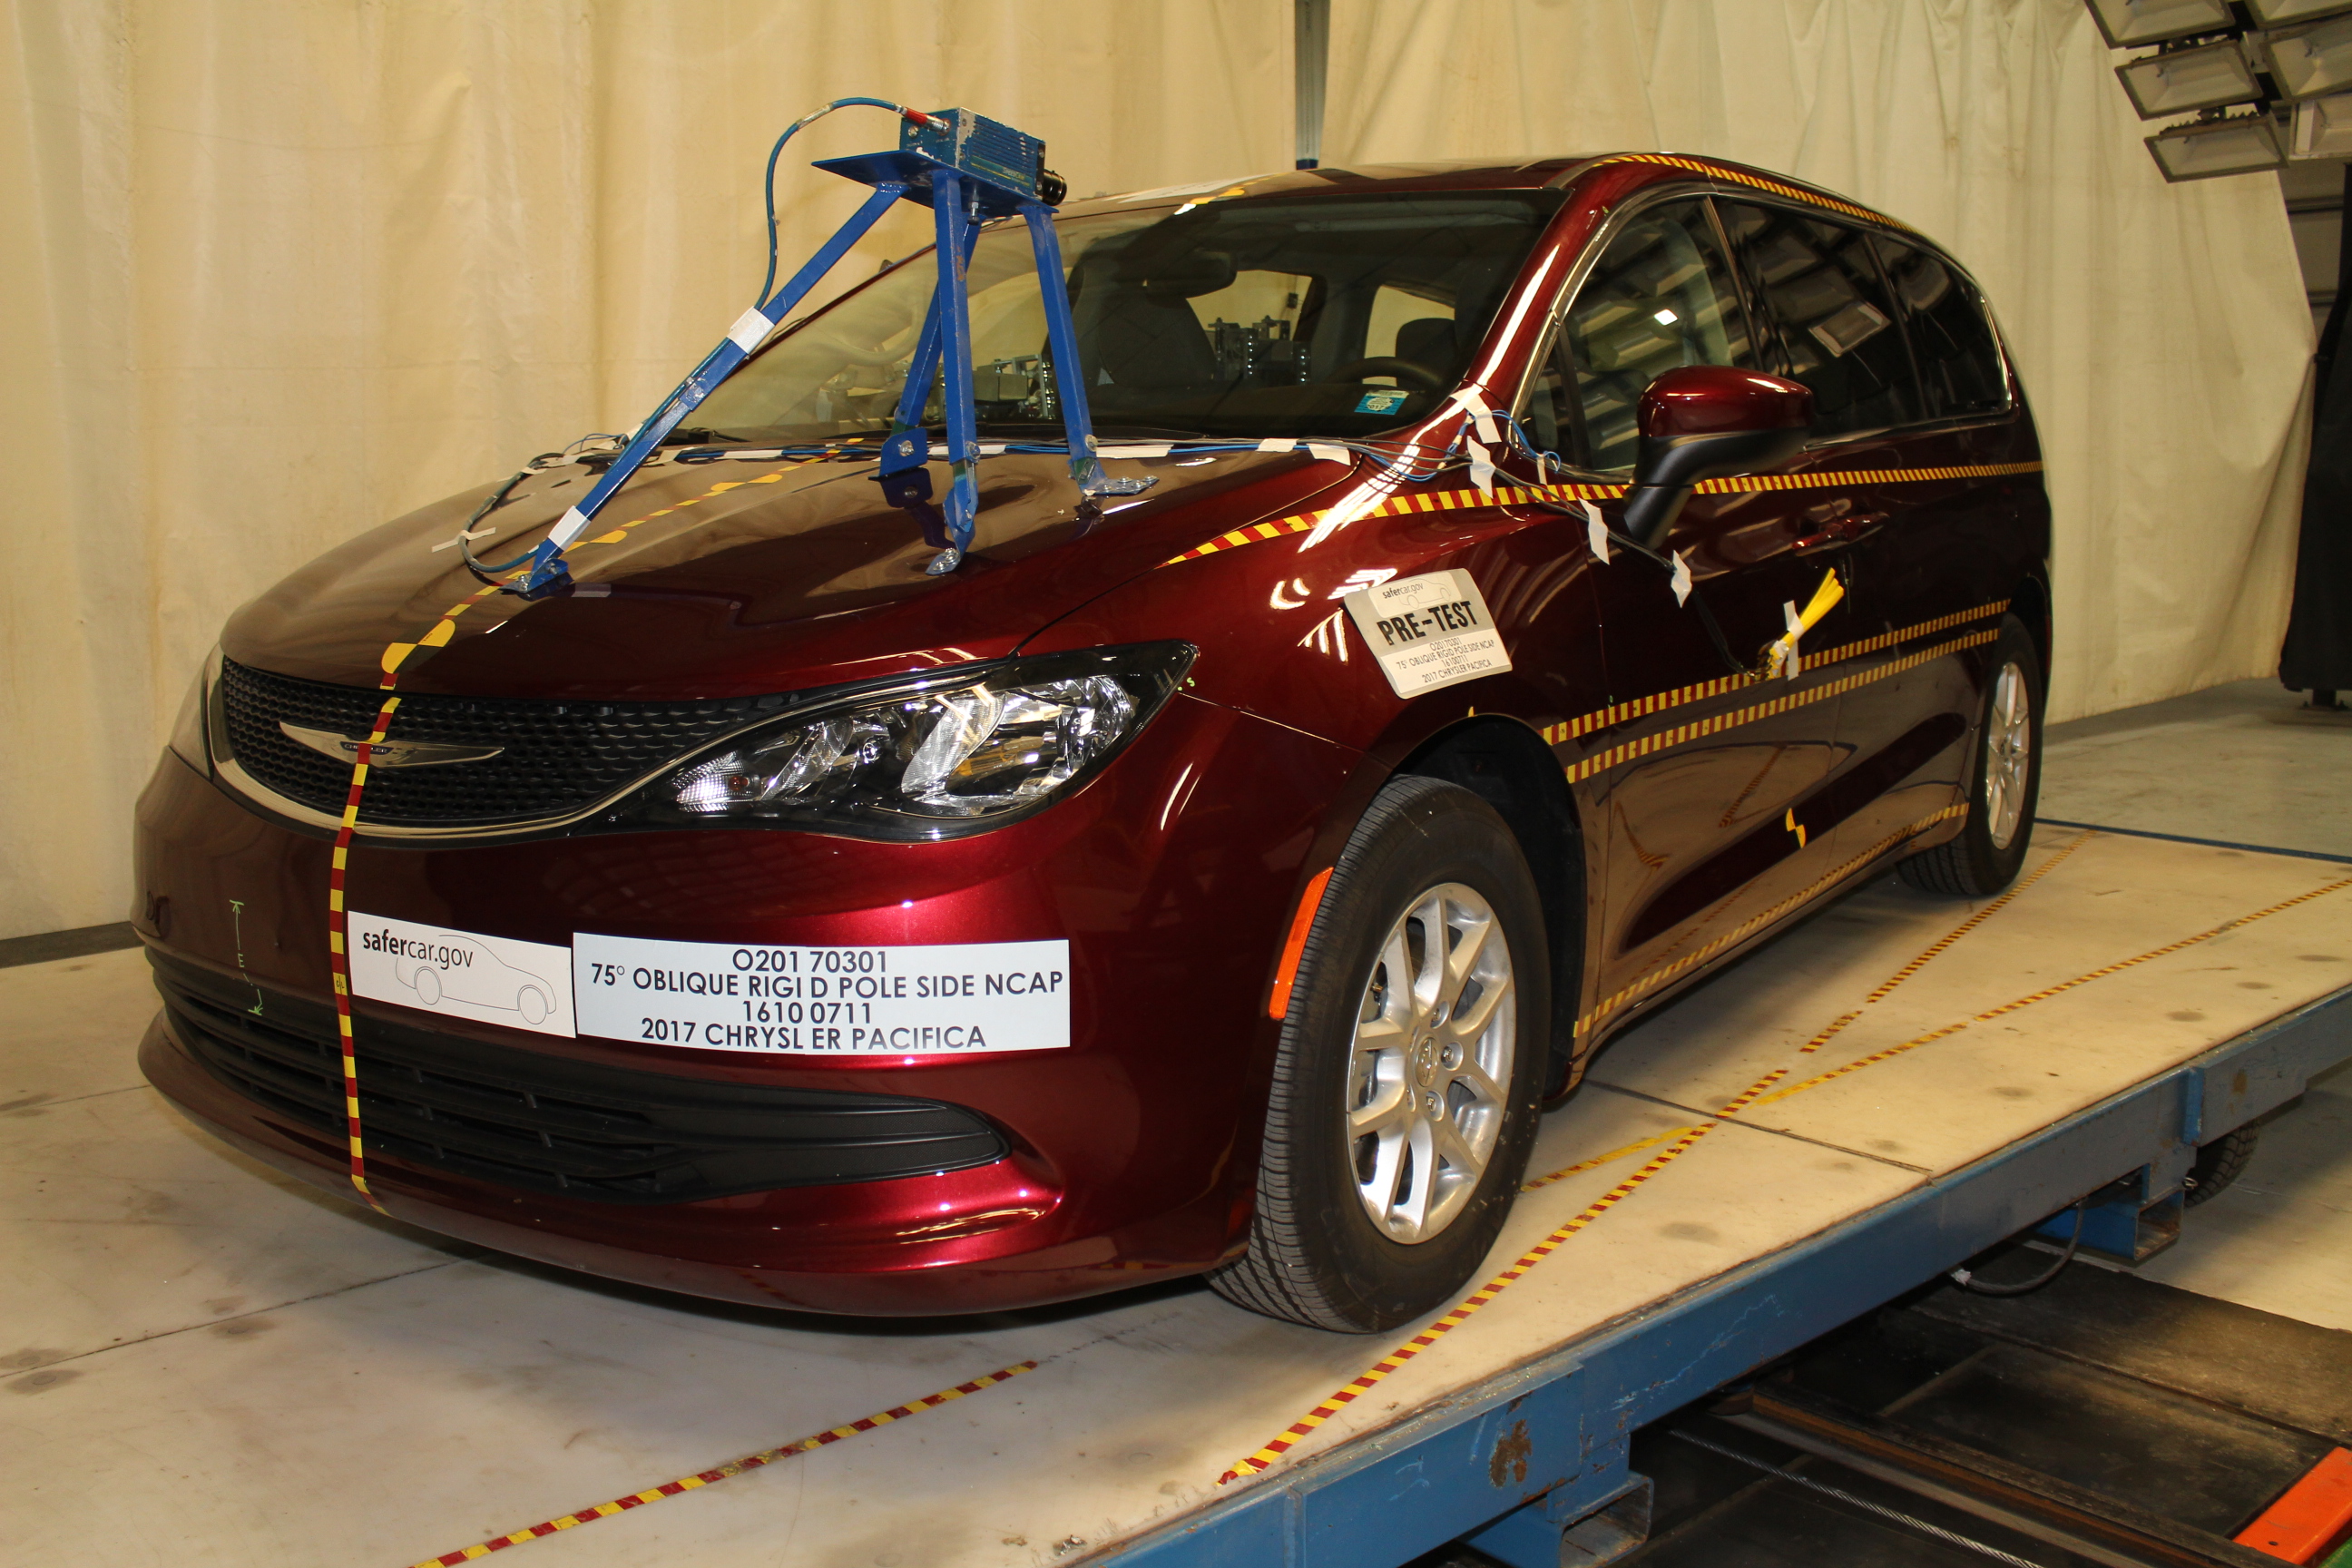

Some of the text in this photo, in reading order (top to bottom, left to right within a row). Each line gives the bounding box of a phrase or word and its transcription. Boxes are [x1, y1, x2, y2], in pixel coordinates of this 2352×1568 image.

[1382, 583, 1424, 599] safercar.gov
[1377, 601, 1477, 645] PRE-TEST
[1408, 652, 1438, 667] OBLIQUE
[1436, 648, 1455, 659] RIGID
[1454, 644, 1469, 654] POLE
[1467, 642, 1481, 652] SIDE
[1479, 639, 1494, 649] NCAP
[1422, 659, 1493, 682] 2017 CHRYSLER PACIFICA
[362, 928, 474, 970] safercar.gov
[591, 963, 625, 986] 75°
[632, 967, 739, 995] OBLIQUE
[839, 976, 906, 998] POLE
[916, 974, 975, 998] SIDE
[985, 971, 1063, 995] NCAP
[642, 1017, 696, 1043] 2017
[851, 1025, 987, 1050] PACIFICA
